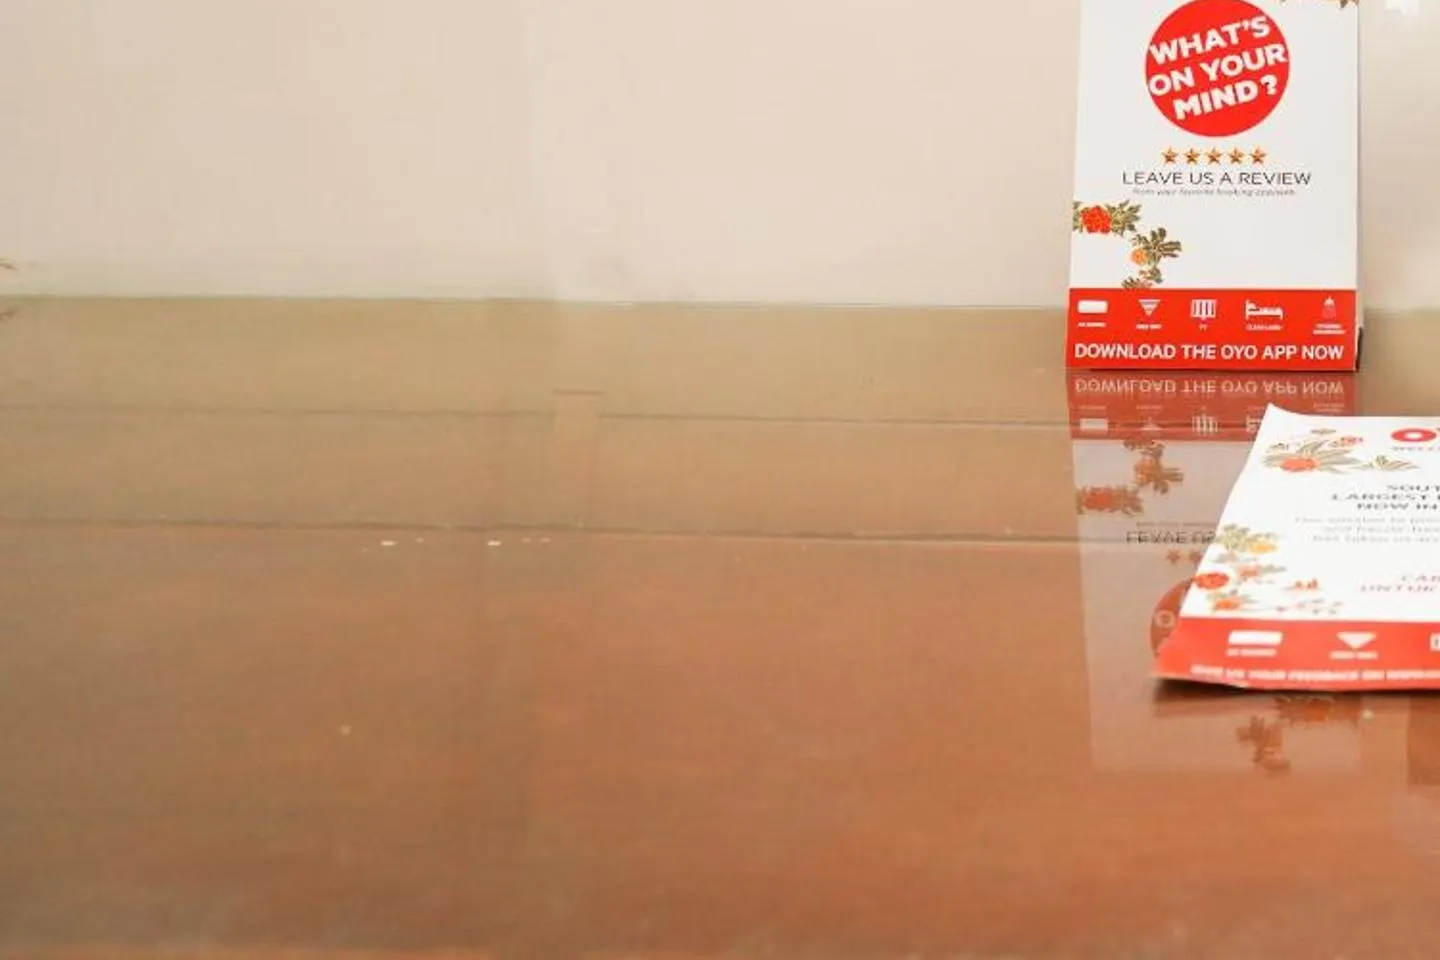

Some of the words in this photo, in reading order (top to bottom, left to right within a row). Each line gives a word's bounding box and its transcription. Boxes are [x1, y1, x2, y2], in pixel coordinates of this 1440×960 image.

[1149, 15, 1270, 65] WHAT'S
[1149, 67, 1195, 96] ON
[1200, 43, 1289, 81] YOUR
[1122, 172, 1183, 185] LEAVE
[1189, 172, 1213, 185] US
[1219, 172, 1234, 185] A
[1239, 172, 1311, 185] REVIEW
[1074, 343, 1176, 359] DOWNLOAD
[1182, 344, 1216, 359] THE
[1220, 344, 1256, 359] OYO
[1262, 344, 1297, 360] APP
[1302, 344, 1344, 360] NOW
[1331, 493, 1429, 502] LARGEST
[1357, 503, 1411, 511] NOW
[1416, 503, 1437, 511] IN
